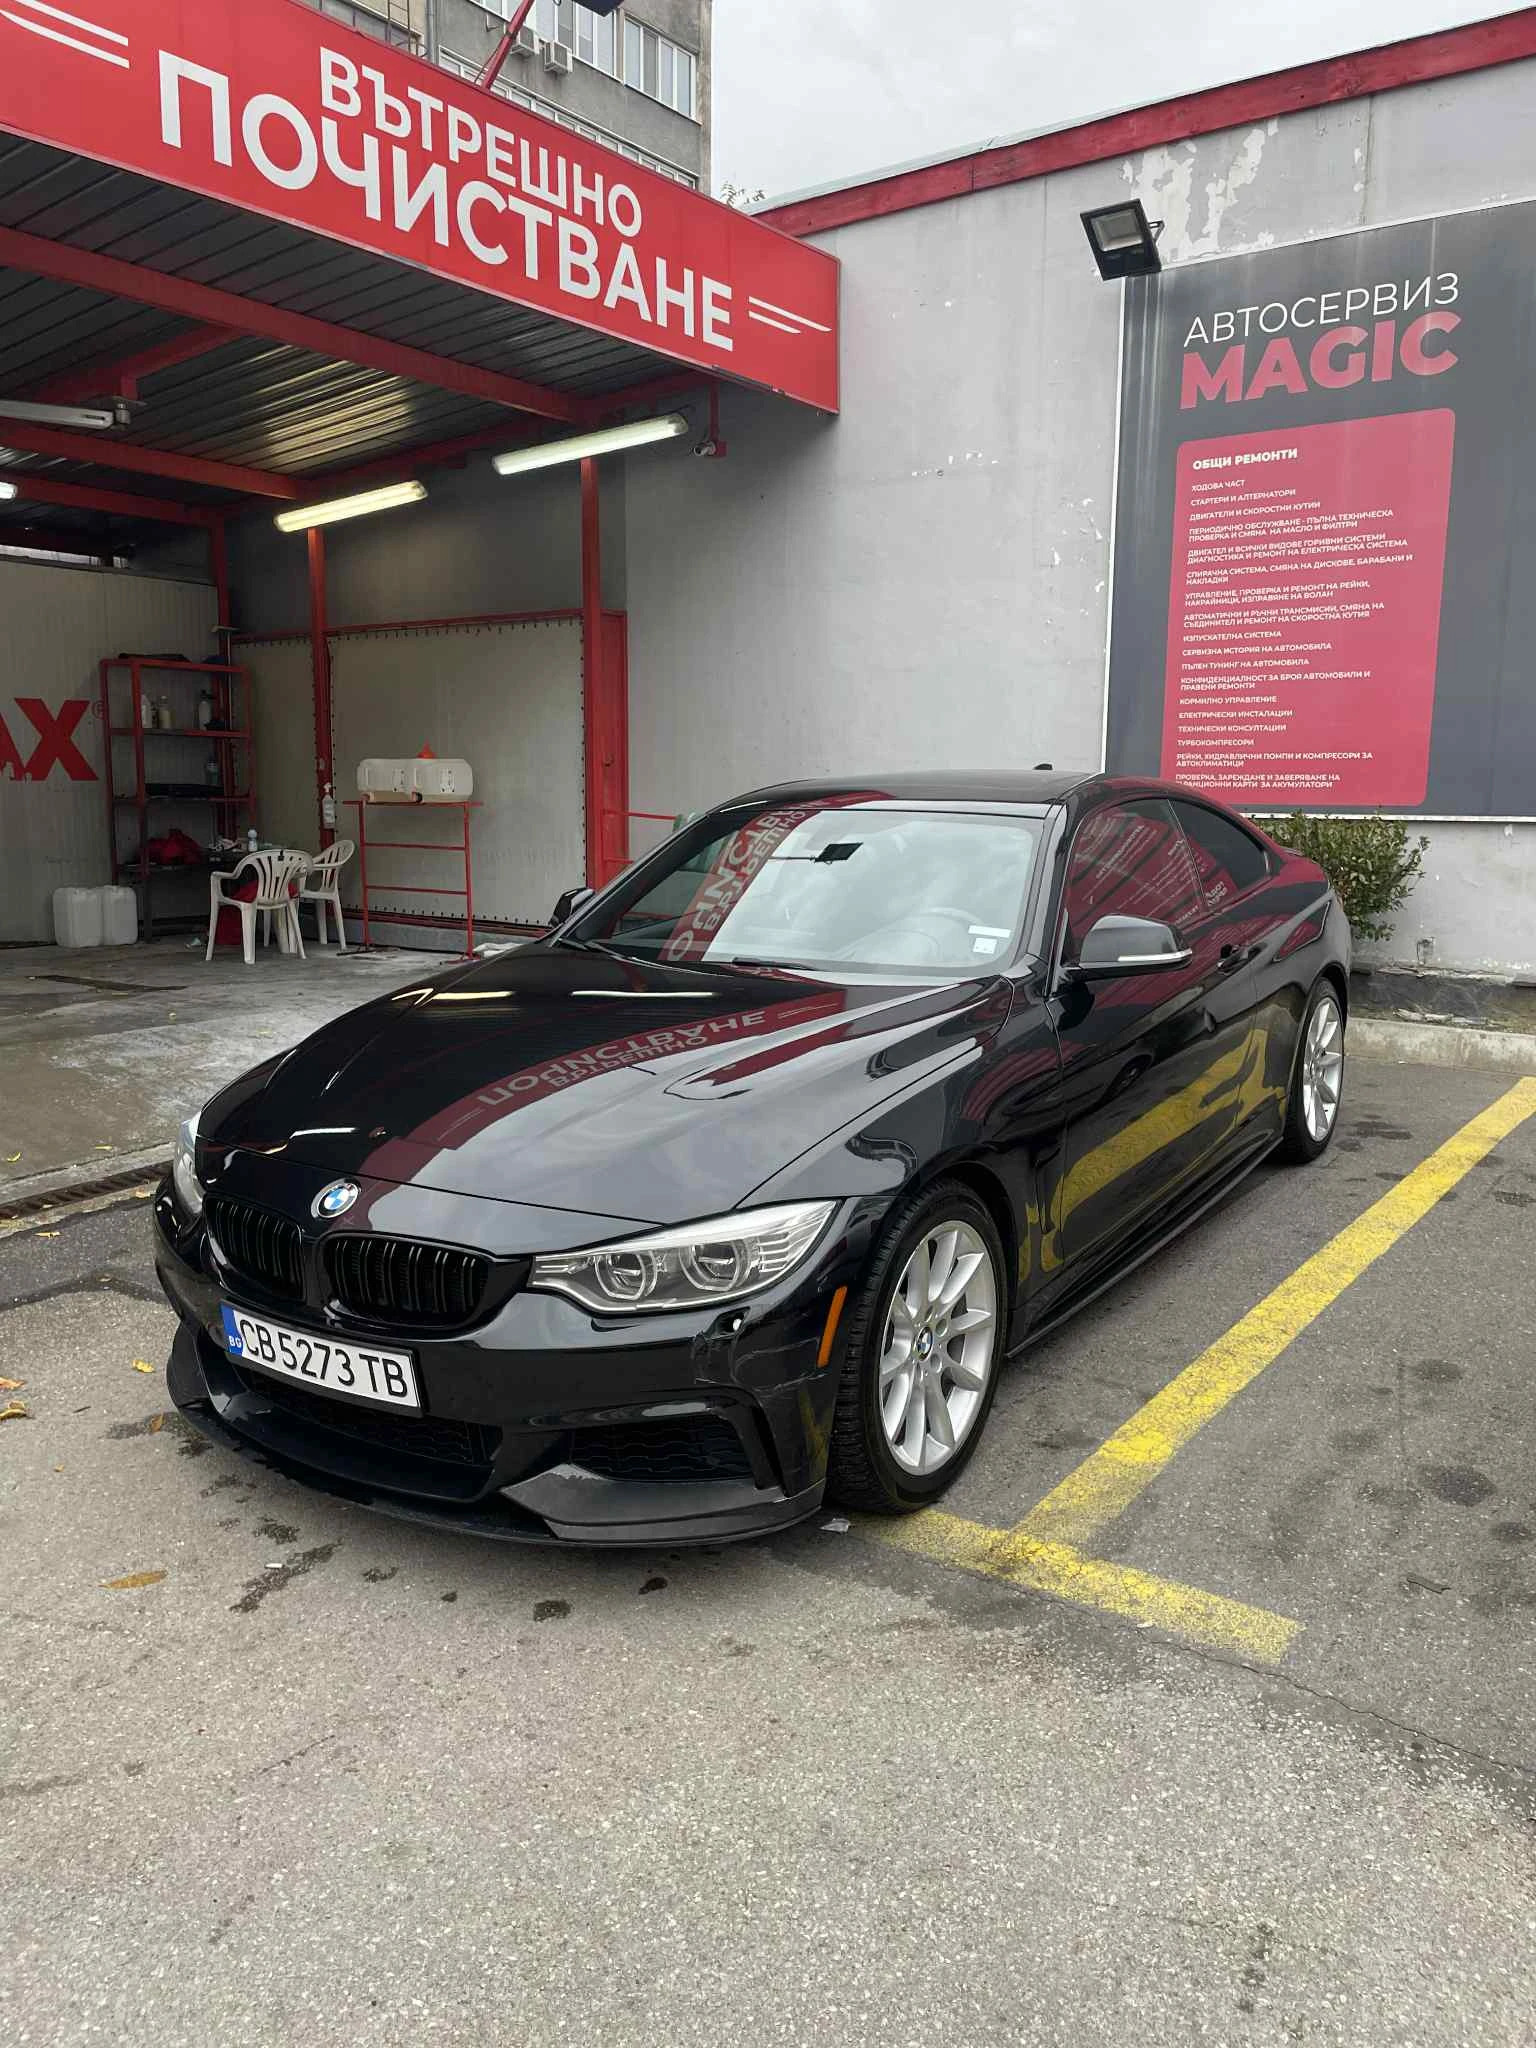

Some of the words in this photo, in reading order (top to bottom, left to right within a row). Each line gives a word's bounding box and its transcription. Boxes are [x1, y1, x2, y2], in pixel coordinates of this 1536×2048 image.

[318, 45, 644, 238] ВЪТРЕШНО
[156, 48, 735, 353] ПОЧИСТВАНЕ
[1183, 272, 1460, 348] АВТОСЕРВИЗ
[1179, 311, 1462, 411] MAGIC
[1192, 456, 1232, 470] ОБЩИ
[1234, 448, 1298, 466] РЕМОНТИ
[1191, 482, 1224, 492] ХОДОВА
[1224, 479, 1246, 487] ЧАСТ
[1191, 496, 1229, 506] СТАРТЕРИ
[1237, 489, 1296, 501] АЛТЕРНАТОРИ
[1190, 510, 1234, 521] ДВИГАТЕЛИ
[1242, 504, 1291, 515] СКОРОСТНИ
[1293, 502, 1320, 510] КУТИИ
[1189, 523, 1243, 534] ПЕРИОДИЧНО
[1245, 518, 1301, 530] ОБСЛУЖВАНЕ
[1307, 514, 1336, 524] ПЪЛНА
[1338, 509, 1393, 520] ТЕХНИЧЕСКА
[1189, 531, 1230, 542] ПРОВЕРКА
[1238, 529, 1267, 538] СМЯНА
[1283, 525, 1312, 533] МАСЛО
[1322, 521, 1358, 530] ФИЛТРИ
[1188, 547, 1227, 558] ДВИГАТЕЛ
[1235, 543, 1267, 553] ВСИЧКИ
[1268, 540, 1302, 550] ВИДОВЕ
[1304, 537, 1343, 547] ГОРИВНИ
[1344, 533, 1386, 543] СИСТЕМИ
[1188, 554, 1245, 565] ДИАГНОСТИКА
[1253, 549, 1286, 559] РЕМОНТ
[1300, 543, 1365, 555] ЕЛЕКТРИЧЕСКА
[1366, 539, 1408, 549] СИСТЕМА
[1186, 568, 1229, 579] СПИРАЧНА
[1269, 563, 1299, 572] СМЯНА
[1357, 555, 1405, 565] БАРАБАНИ
[1186, 576, 1229, 585] НАКЛАДКИ
[1240, 587, 1281, 595] ПРОВЕРКА
[1290, 583, 1325, 592] РЕМОНТ
[1303, 590, 1334, 599] ВОЛАН
[1184, 611, 1242, 621] АВТОМАТИЧНИ
[1340, 603, 1371, 612] СМЯНА
[1372, 602, 1385, 610] НА
[1184, 618, 1236, 628] СЪЕДИНИТЕЛ
[1244, 616, 1277, 625] РЕМОНТ
[1290, 613, 1342, 622] СКОРОСТНА
[1342, 611, 1370, 619] КУТИЯ
[1183, 632, 1244, 642] ИЗПУСКАТЕЛНА
[1244, 630, 1282, 639] СИСТЕМА
[1182, 648, 1223, 656] СЕРВИЗНА
[1223, 646, 1260, 655] ИСТОРИЯ
[1274, 643, 1332, 652] АВТОМОБИЛА
[1209, 661, 1239, 669] ТУНИНГ
[1253, 658, 1310, 667] АВТОМОБИЛА
[1181, 674, 1268, 684] КОНФИДЕНЦИАЛНОСТ
[1303, 671, 1363, 680] АВТОМОБИЛИ
[1179, 697, 1225, 705] КОРМИЛНО
[1225, 695, 1277, 704] УПРАВЛЕНИЕ
[1179, 711, 1237, 719] ЕЛЕКТРИЧЕСКИ
[1238, 710, 1293, 718] ИНСТАЛАЦИИ
[1178, 725, 1227, 733] ТЕХНИЧЕСКИ
[1227, 724, 1287, 732] КОНСУЛТАЦИИ
[1176, 760, 1244, 768] АВТОКЛИМАТИЦИ
[1204, 753, 1262, 761] ХИДРАВЛИЧНИ
[1218, 774, 1266, 782] ЗАРЕЖДАНЕ
[229, 1335, 242, 1349] BG
